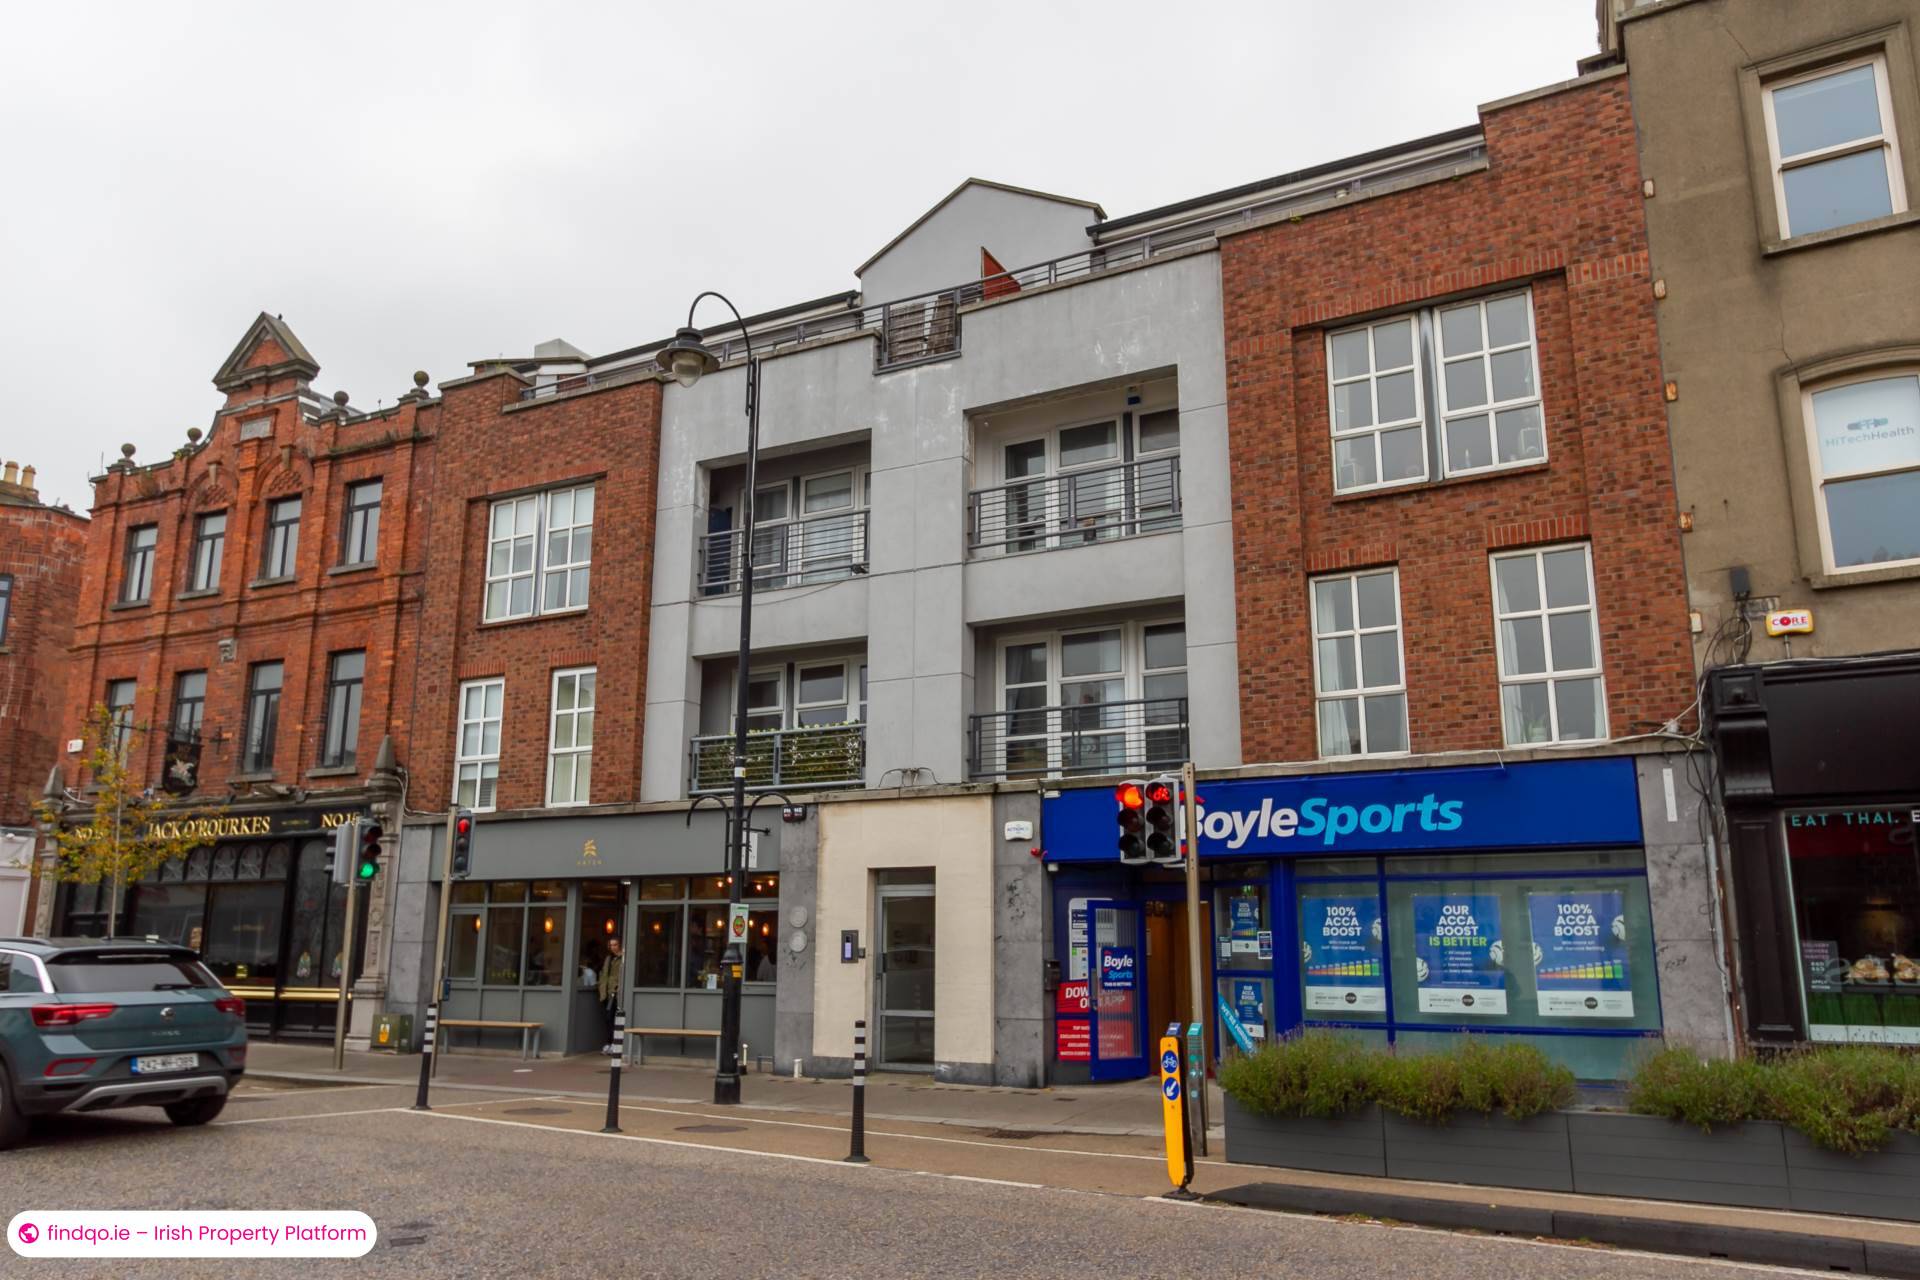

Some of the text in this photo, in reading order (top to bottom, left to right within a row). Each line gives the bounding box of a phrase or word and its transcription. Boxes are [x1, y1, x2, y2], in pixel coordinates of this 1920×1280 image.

[1825, 425, 1915, 448] HiTechHealth
[1772, 616, 1809, 625] CORE
[1179, 793, 1463, 849] BoyleSports
[1791, 814, 1828, 826] EAT
[147, 815, 271, 839] JACK O'ROURKES
[1326, 906, 1356, 916] 100%
[1442, 905, 1469, 915] OUR
[1557, 904, 1593, 914] 100%
[1325, 917, 1359, 926] ACCA
[1438, 916, 1476, 925] ACCA
[1556, 915, 1597, 925] ACCA
[1322, 927, 1362, 936] BOOST
[1436, 926, 1479, 936] BOOST
[1554, 926, 1601, 936] BOOST
[1429, 937, 1487, 946] IS BETTER
[1104, 955, 1133, 970] Boyle
[1108, 970, 1133, 981] Sports
